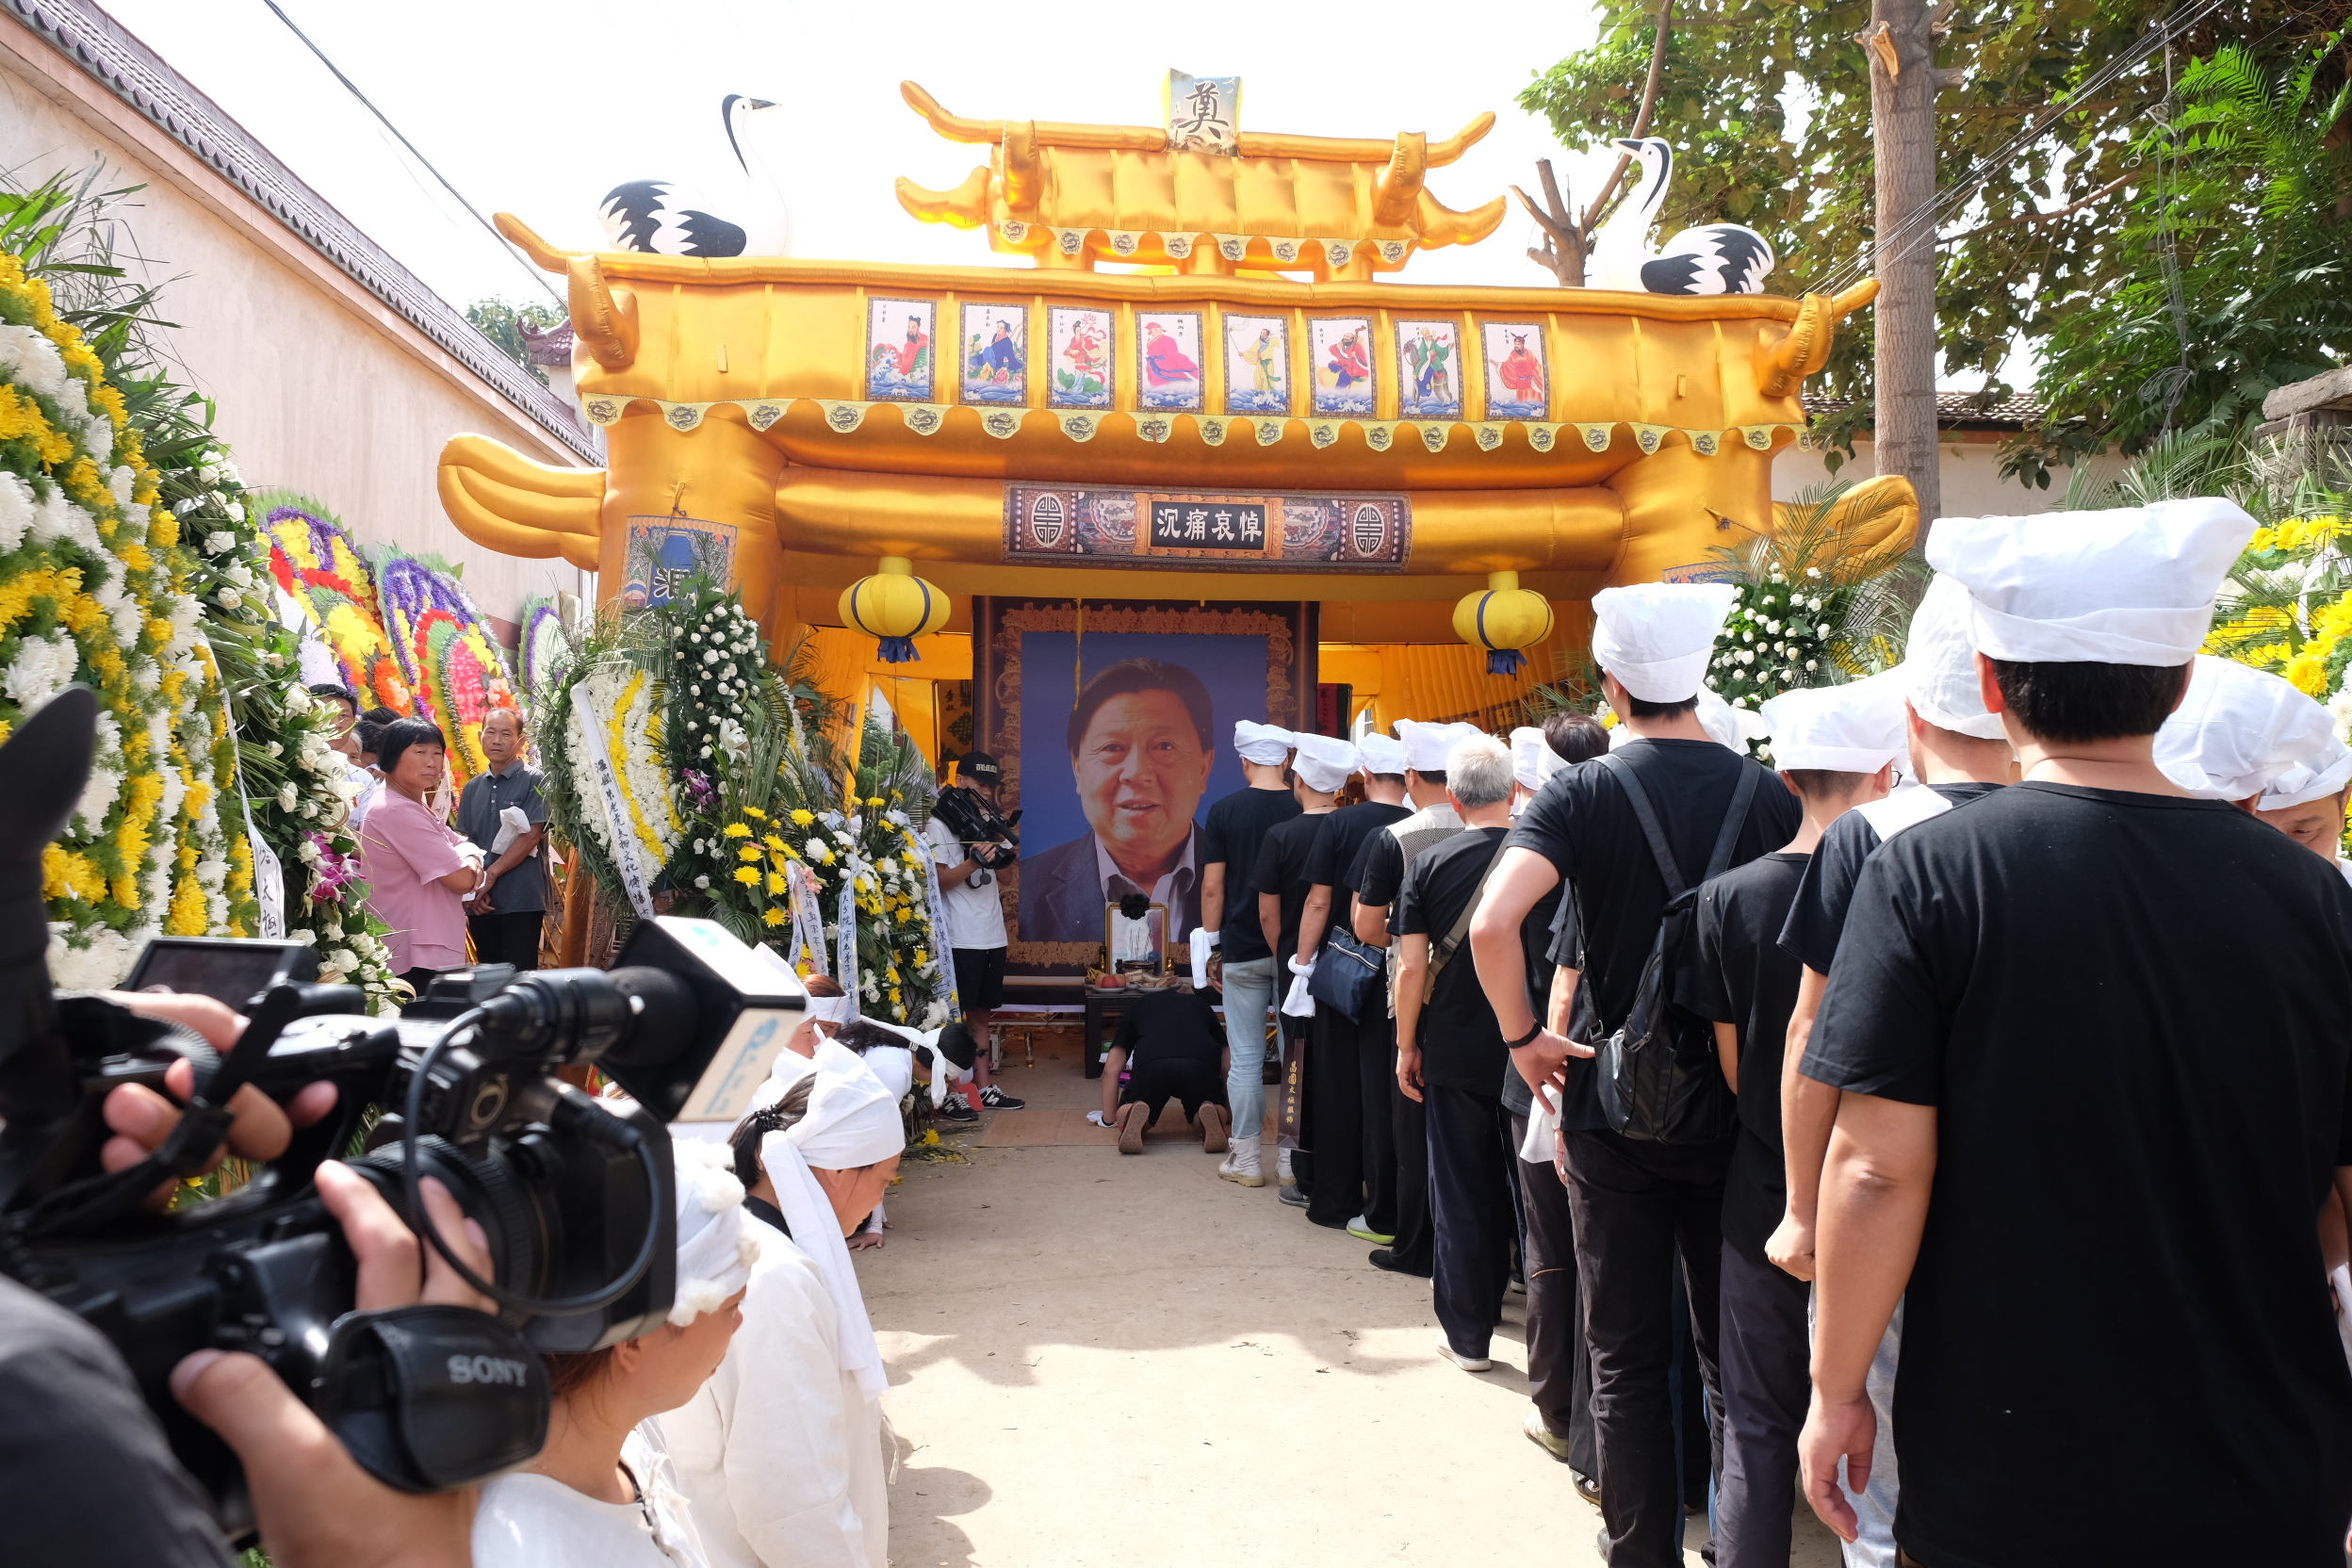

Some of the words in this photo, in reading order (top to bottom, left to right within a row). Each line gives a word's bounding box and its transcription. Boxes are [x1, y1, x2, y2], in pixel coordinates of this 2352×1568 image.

[1176, 80, 1230, 140] 奠
[1157, 508, 1262, 543] 沉痛哀悼
[447, 1354, 528, 1388] SONY
